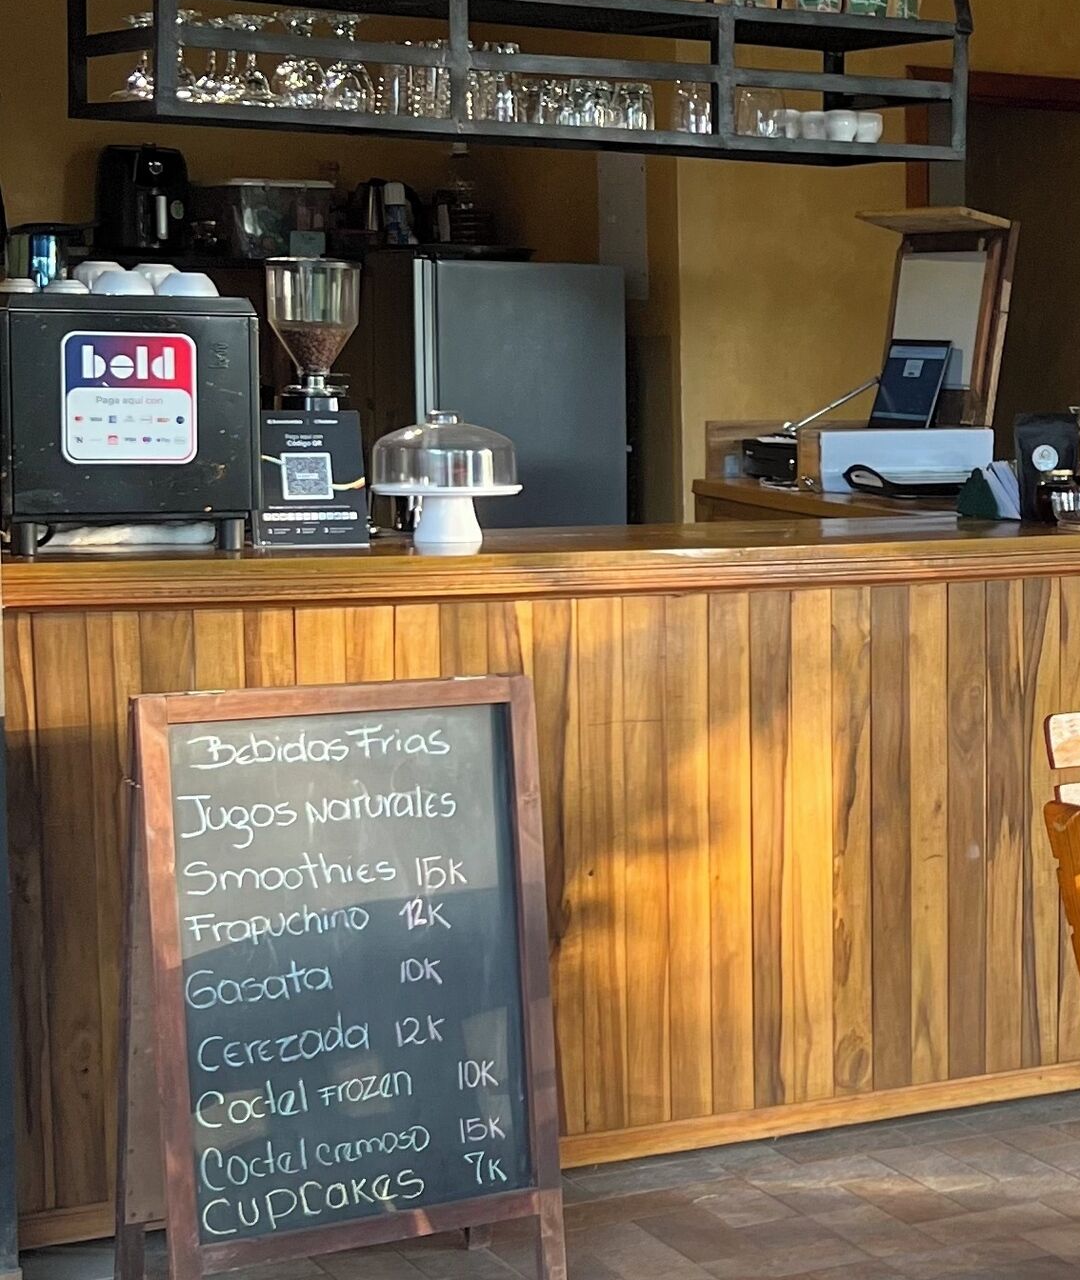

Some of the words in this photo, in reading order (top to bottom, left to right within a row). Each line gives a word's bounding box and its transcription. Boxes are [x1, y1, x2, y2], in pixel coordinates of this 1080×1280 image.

[81, 344, 176, 380] bold
[95, 395, 120, 406] Paga
[186, 729, 350, 770] Bebidas
[345, 723, 451, 759] Frias
[177, 794, 298, 849] Jugos
[183, 852, 397, 896] Smoothies
[185, 905, 370, 945] Frapuchino
[197, 1011, 370, 1072] Cerezada
[196, 1079, 308, 1128] Coctel
[200, 1138, 307, 1191] Coctel
